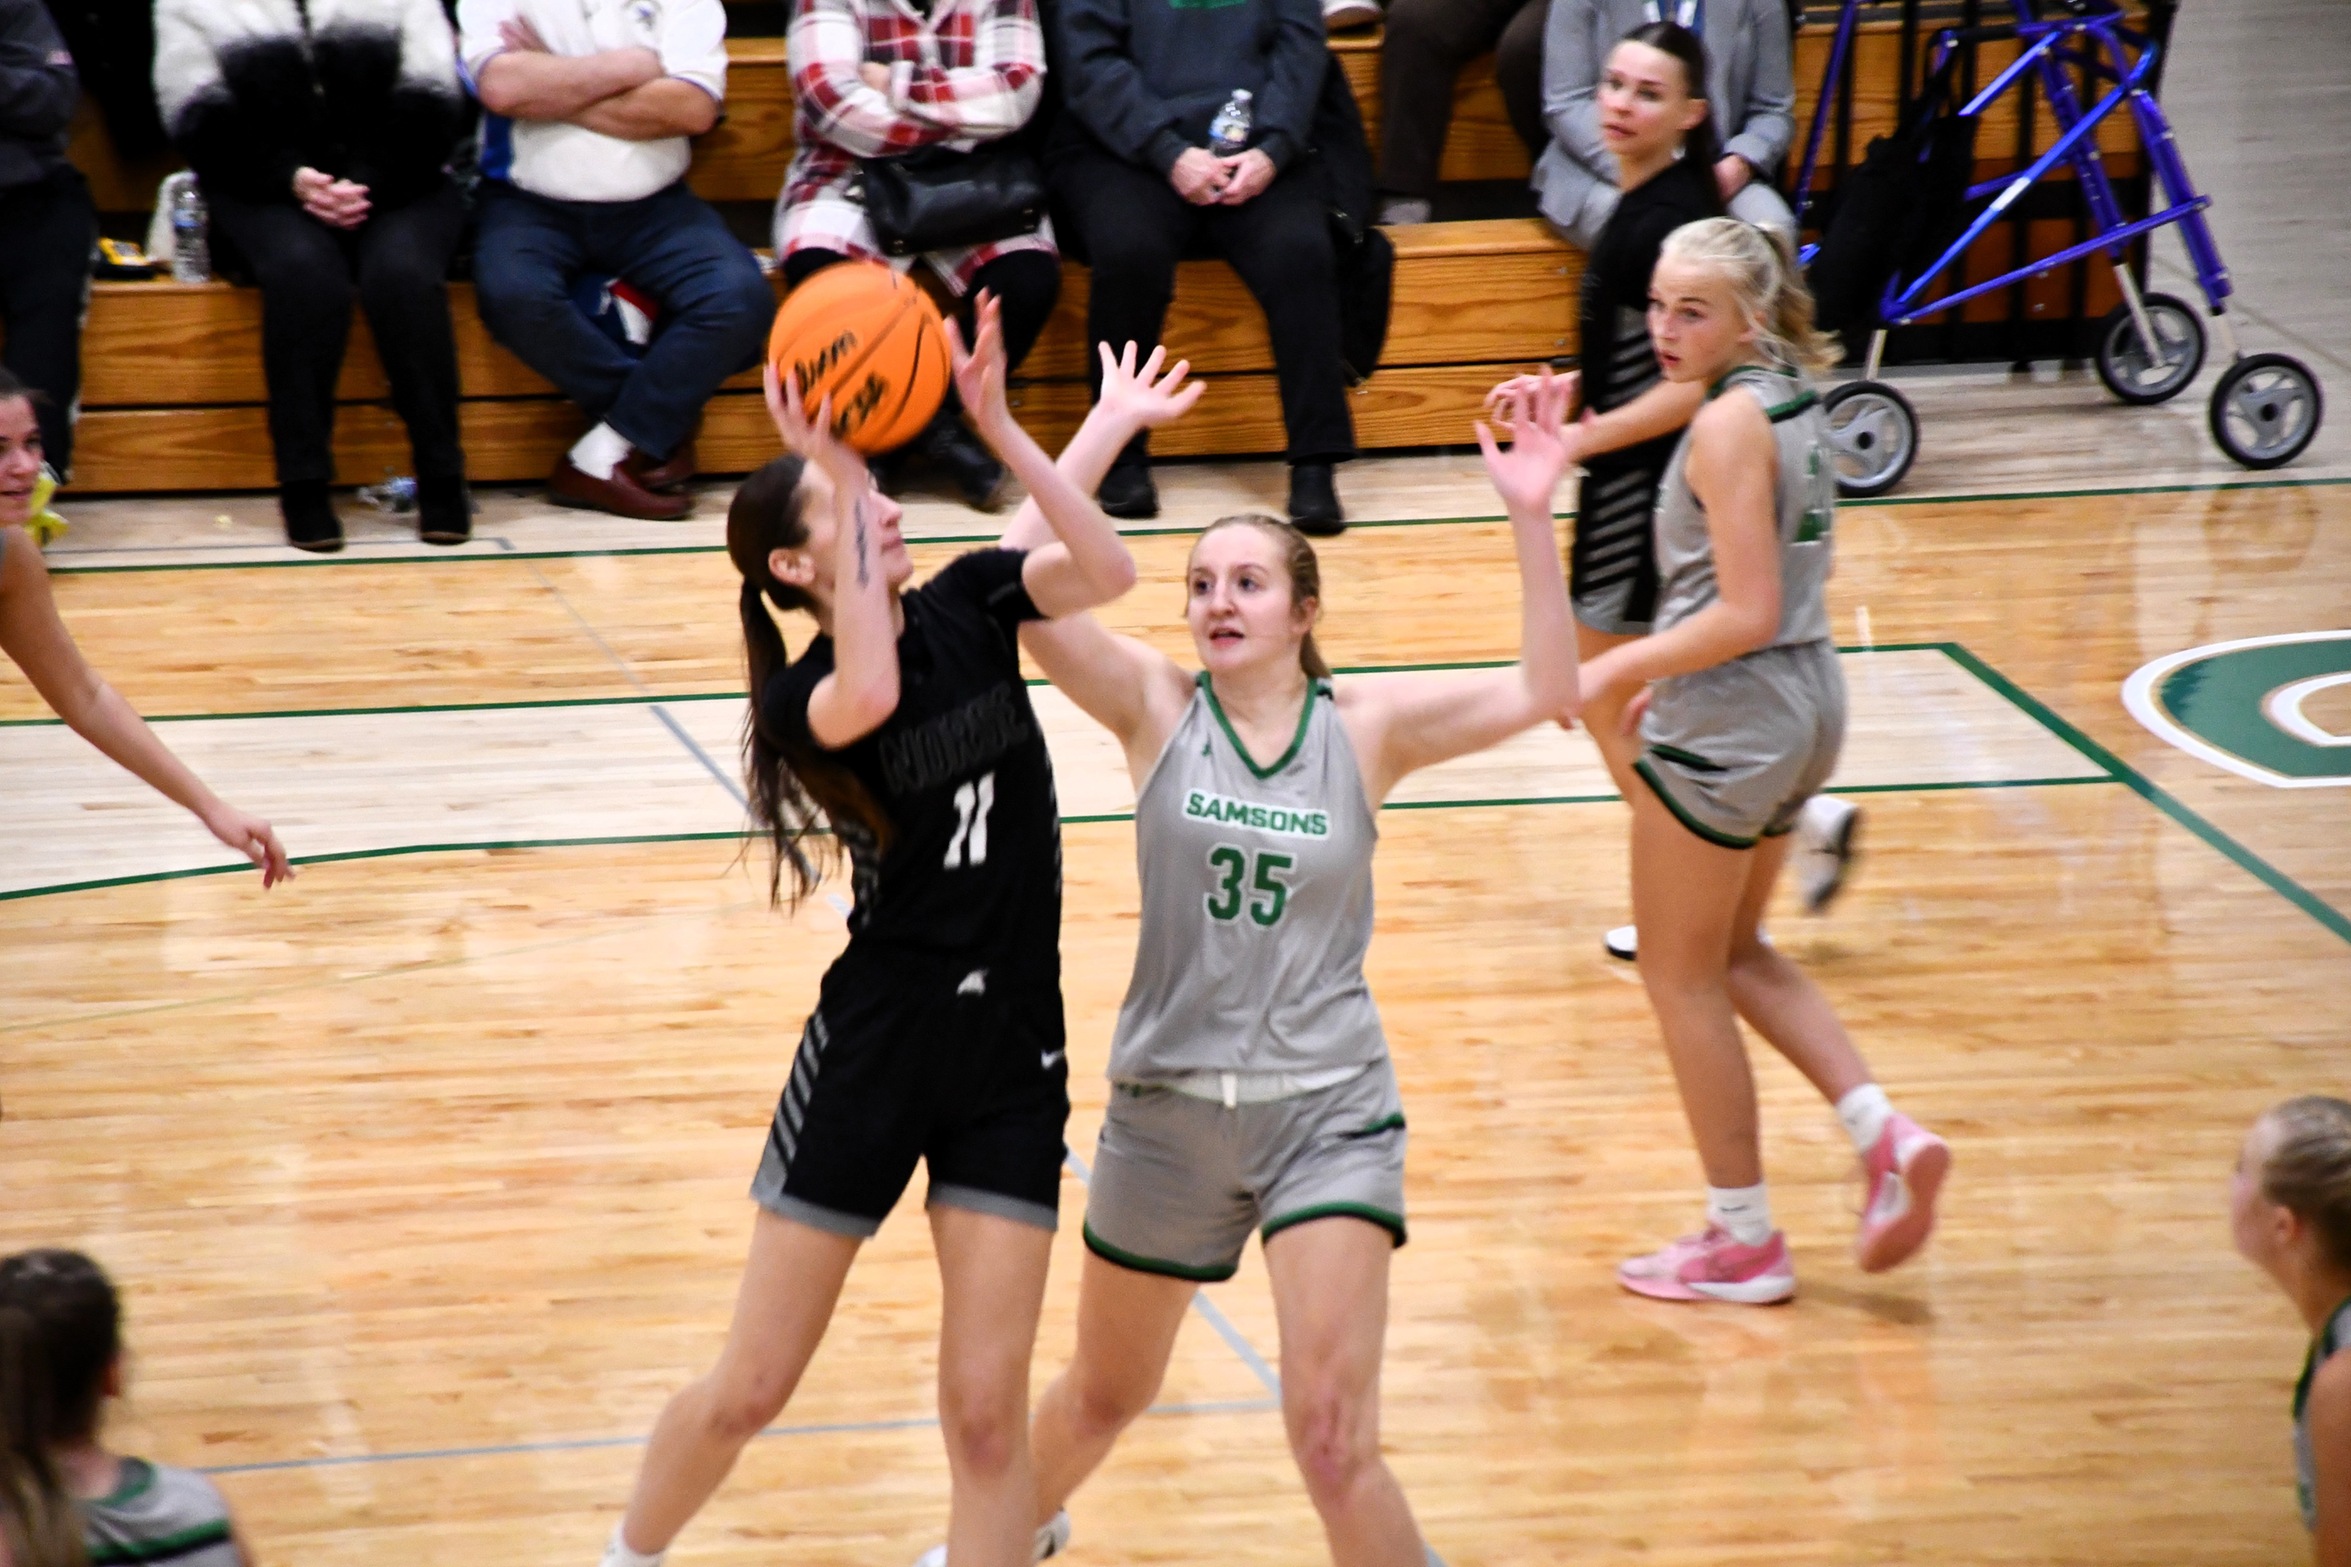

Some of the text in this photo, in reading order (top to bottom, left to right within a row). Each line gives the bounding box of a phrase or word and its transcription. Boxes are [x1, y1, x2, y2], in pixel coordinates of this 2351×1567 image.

[943, 771, 995, 870] 11
[1185, 791, 1328, 837] SAMSONS
[1206, 845, 1294, 928] 35
